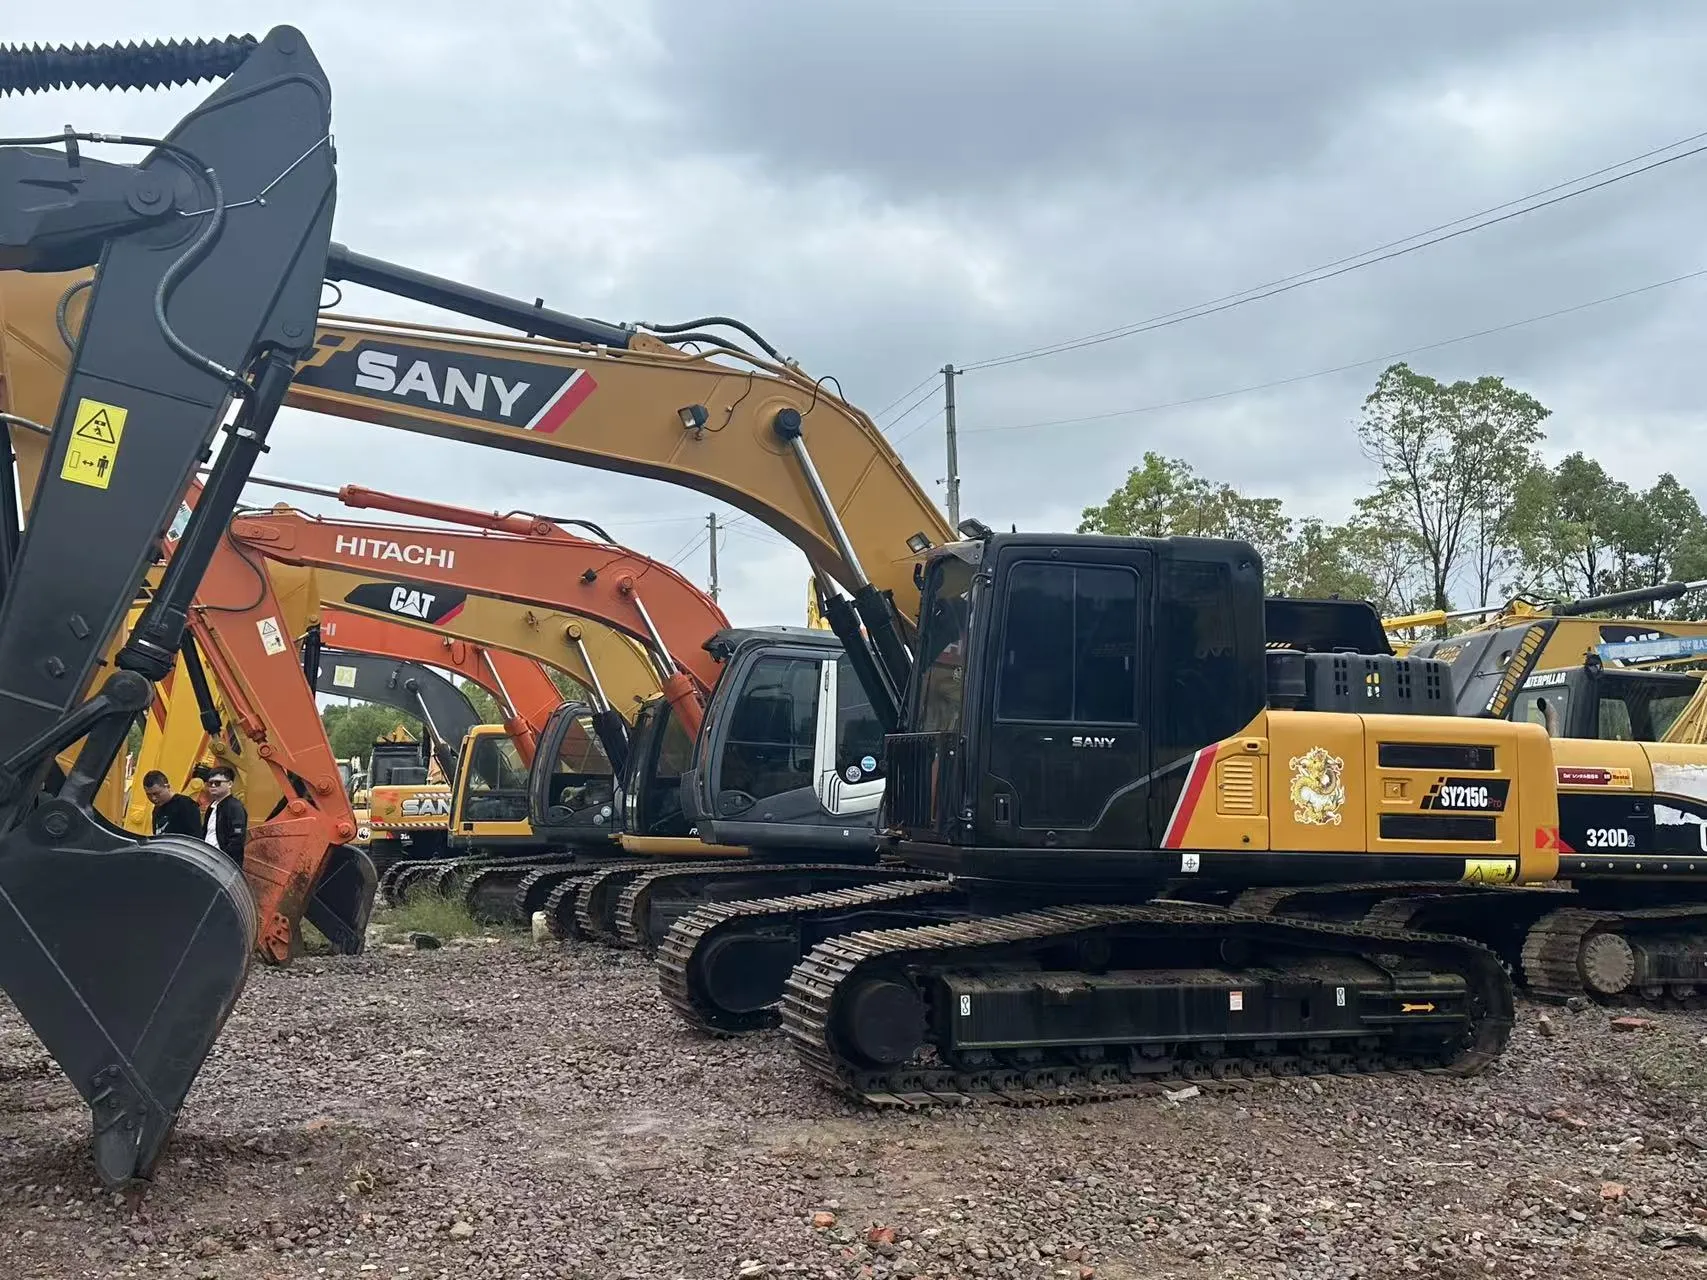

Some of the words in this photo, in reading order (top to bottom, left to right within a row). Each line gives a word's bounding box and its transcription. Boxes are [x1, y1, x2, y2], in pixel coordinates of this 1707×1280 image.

[355, 349, 531, 417] SANY
[335, 535, 456, 569] HITACHI
[389, 586, 436, 619] CAT
[1522, 672, 1567, 688] ATERPILLAR
[1072, 736, 1116, 748] SANY
[401, 799, 452, 816] SAN
[1441, 785, 1488, 808] SY215C
